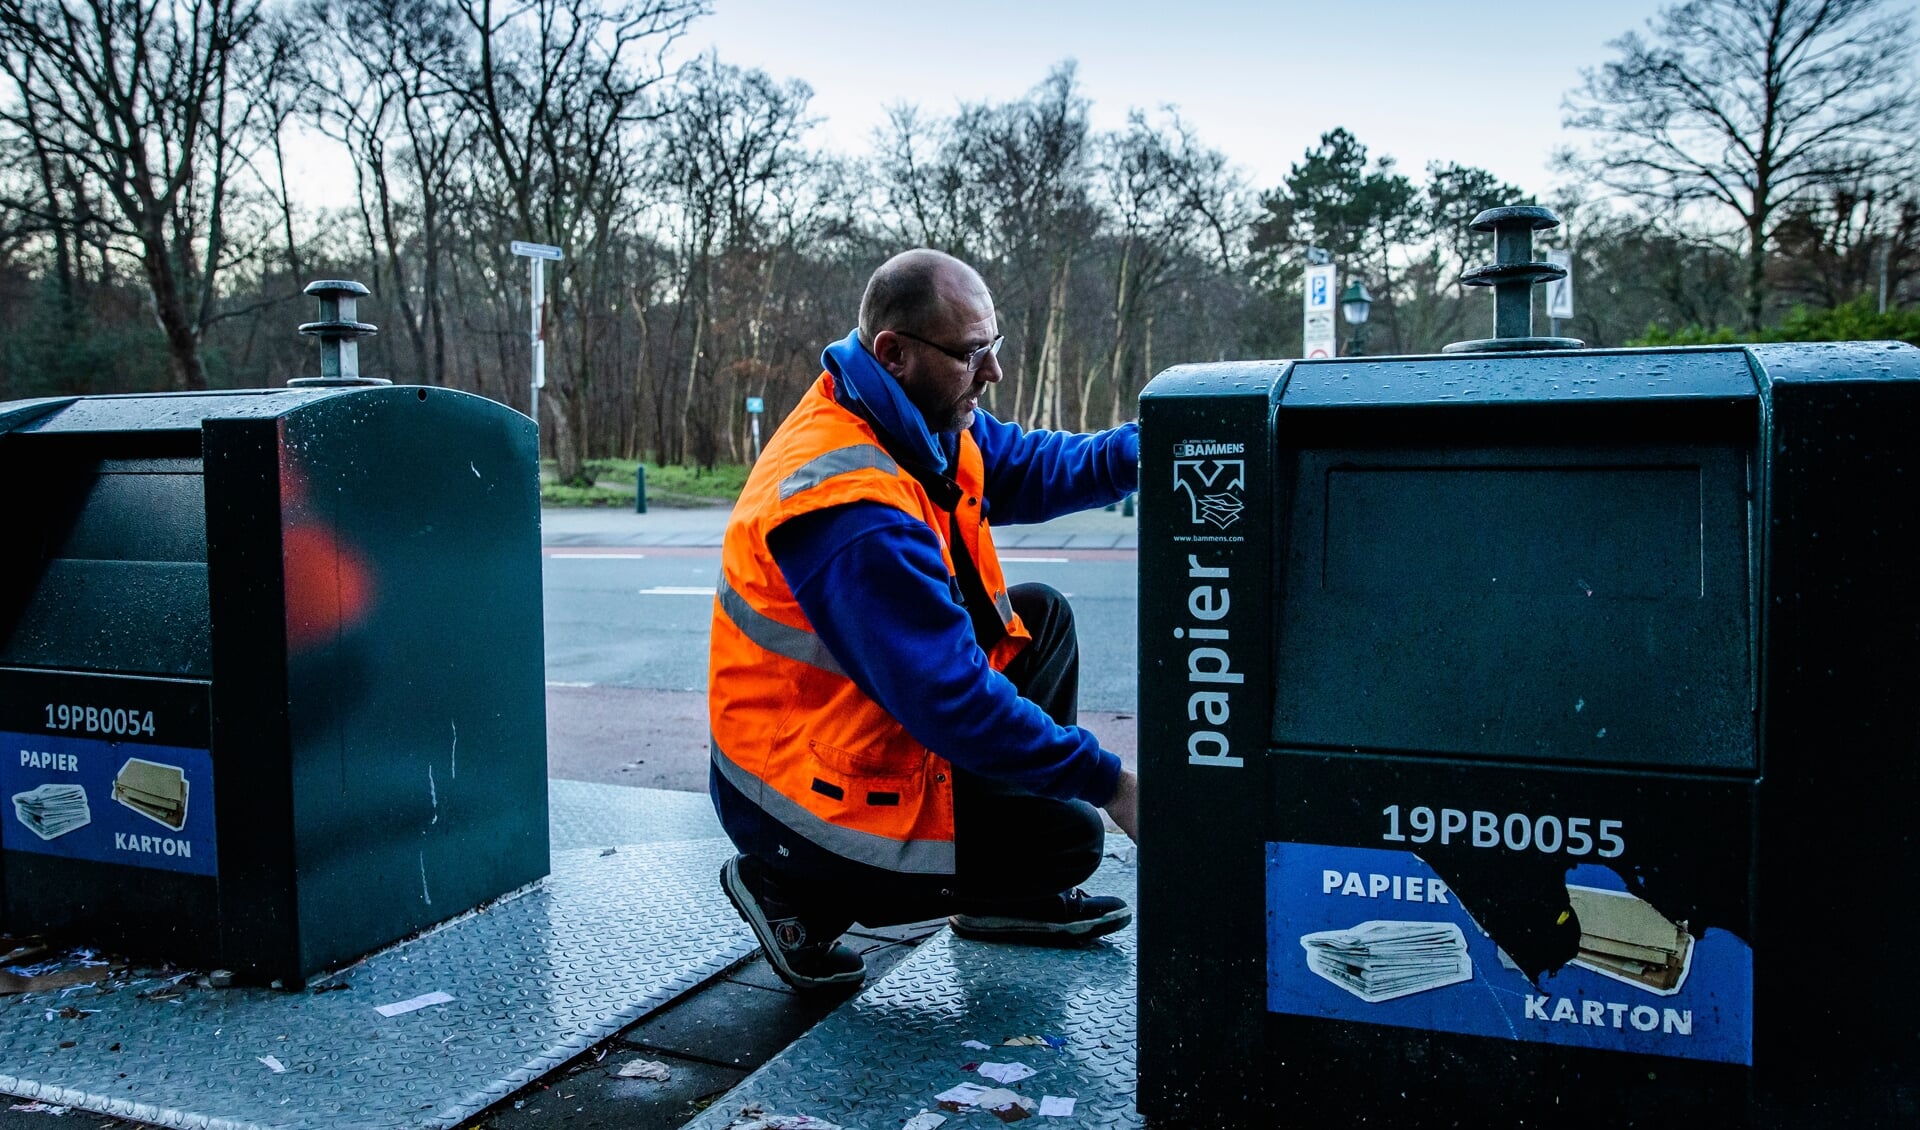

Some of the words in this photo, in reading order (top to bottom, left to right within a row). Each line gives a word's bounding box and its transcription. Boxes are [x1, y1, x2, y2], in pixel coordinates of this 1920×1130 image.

[1184, 443, 1245, 457] BAMMENS
[1173, 534, 1245, 542] www.bammens.com
[1173, 554, 1244, 768] papier
[45, 703, 156, 737] 19PB0054
[20, 750, 79, 772] PAPIER
[115, 832, 191, 858] KARTON
[1382, 804, 1626, 858] 19PB0055
[1322, 869, 1450, 905] PAPIER
[1525, 994, 1693, 1036] KARTON
